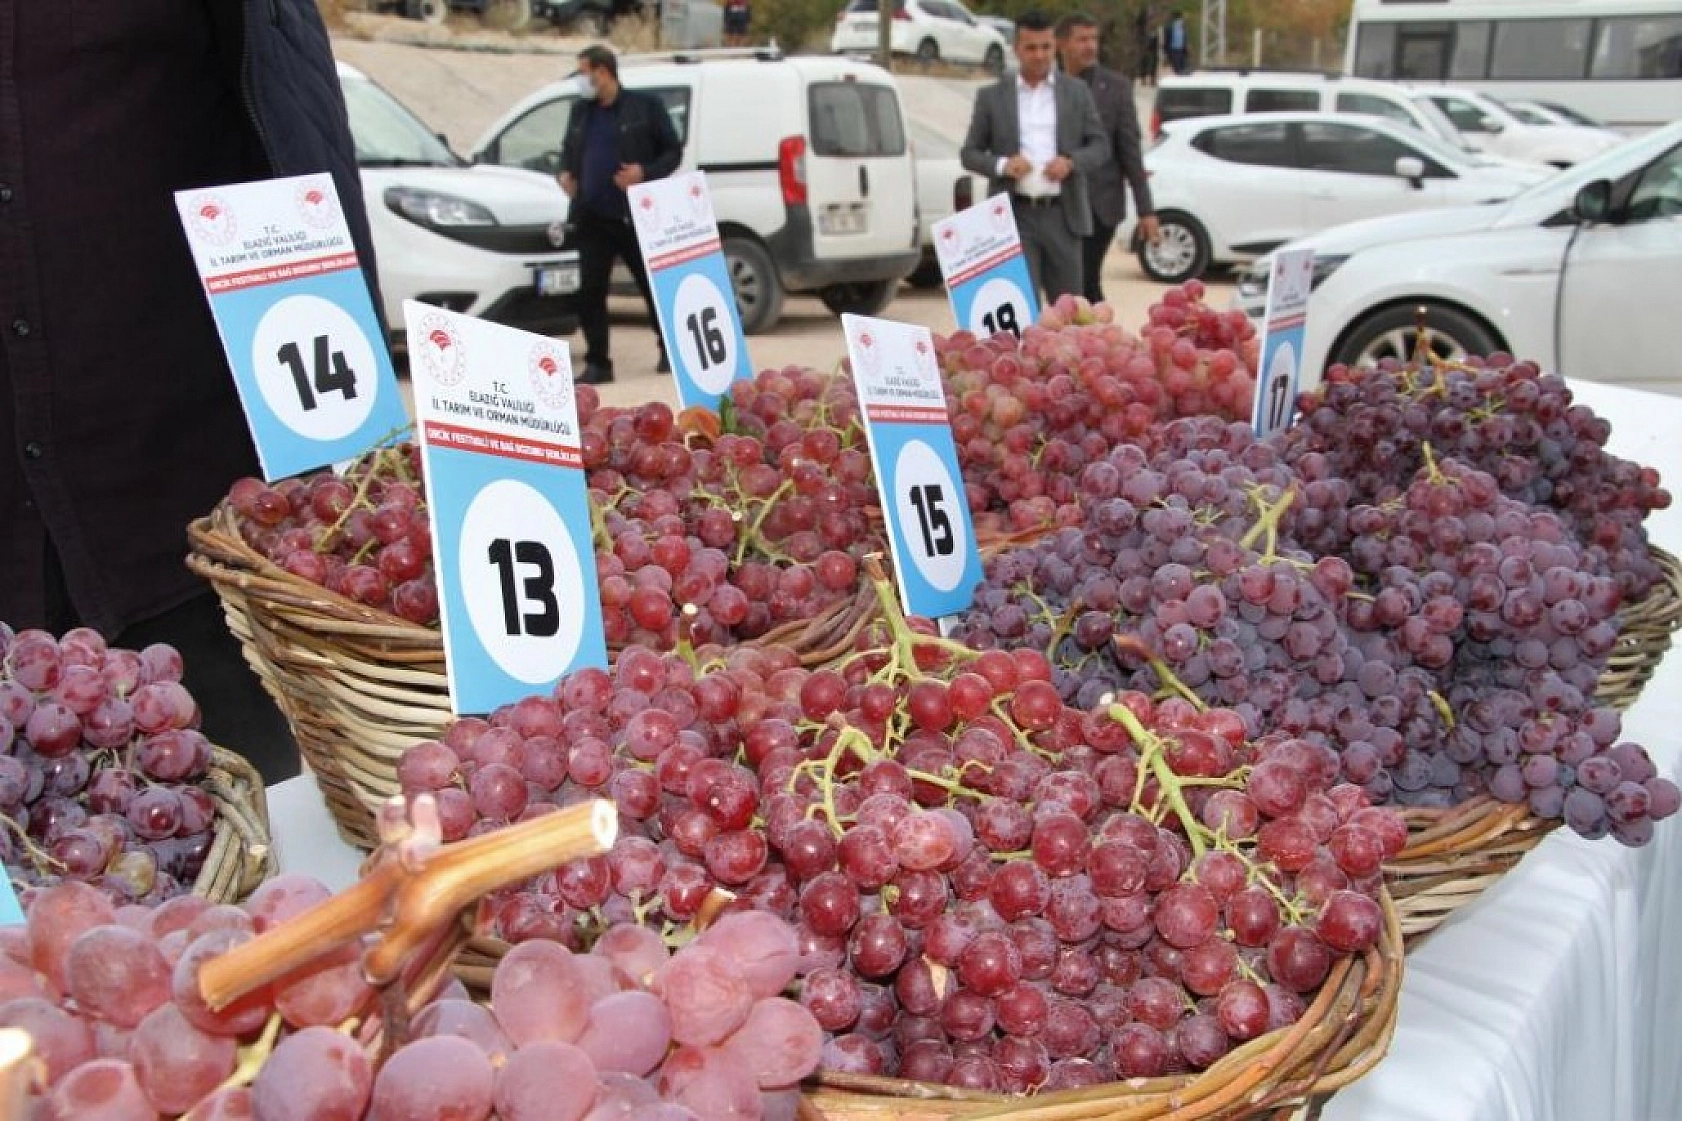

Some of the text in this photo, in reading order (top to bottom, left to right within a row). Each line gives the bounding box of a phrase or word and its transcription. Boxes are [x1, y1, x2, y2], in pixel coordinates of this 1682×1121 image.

[277, 335, 358, 411] 14
[687, 307, 726, 371] 16
[441, 400, 471, 415] TARIM
[487, 409, 518, 425] ORMAN
[1270, 374, 1288, 431] 17
[909, 485, 953, 557] 15
[488, 538, 559, 636] 13
